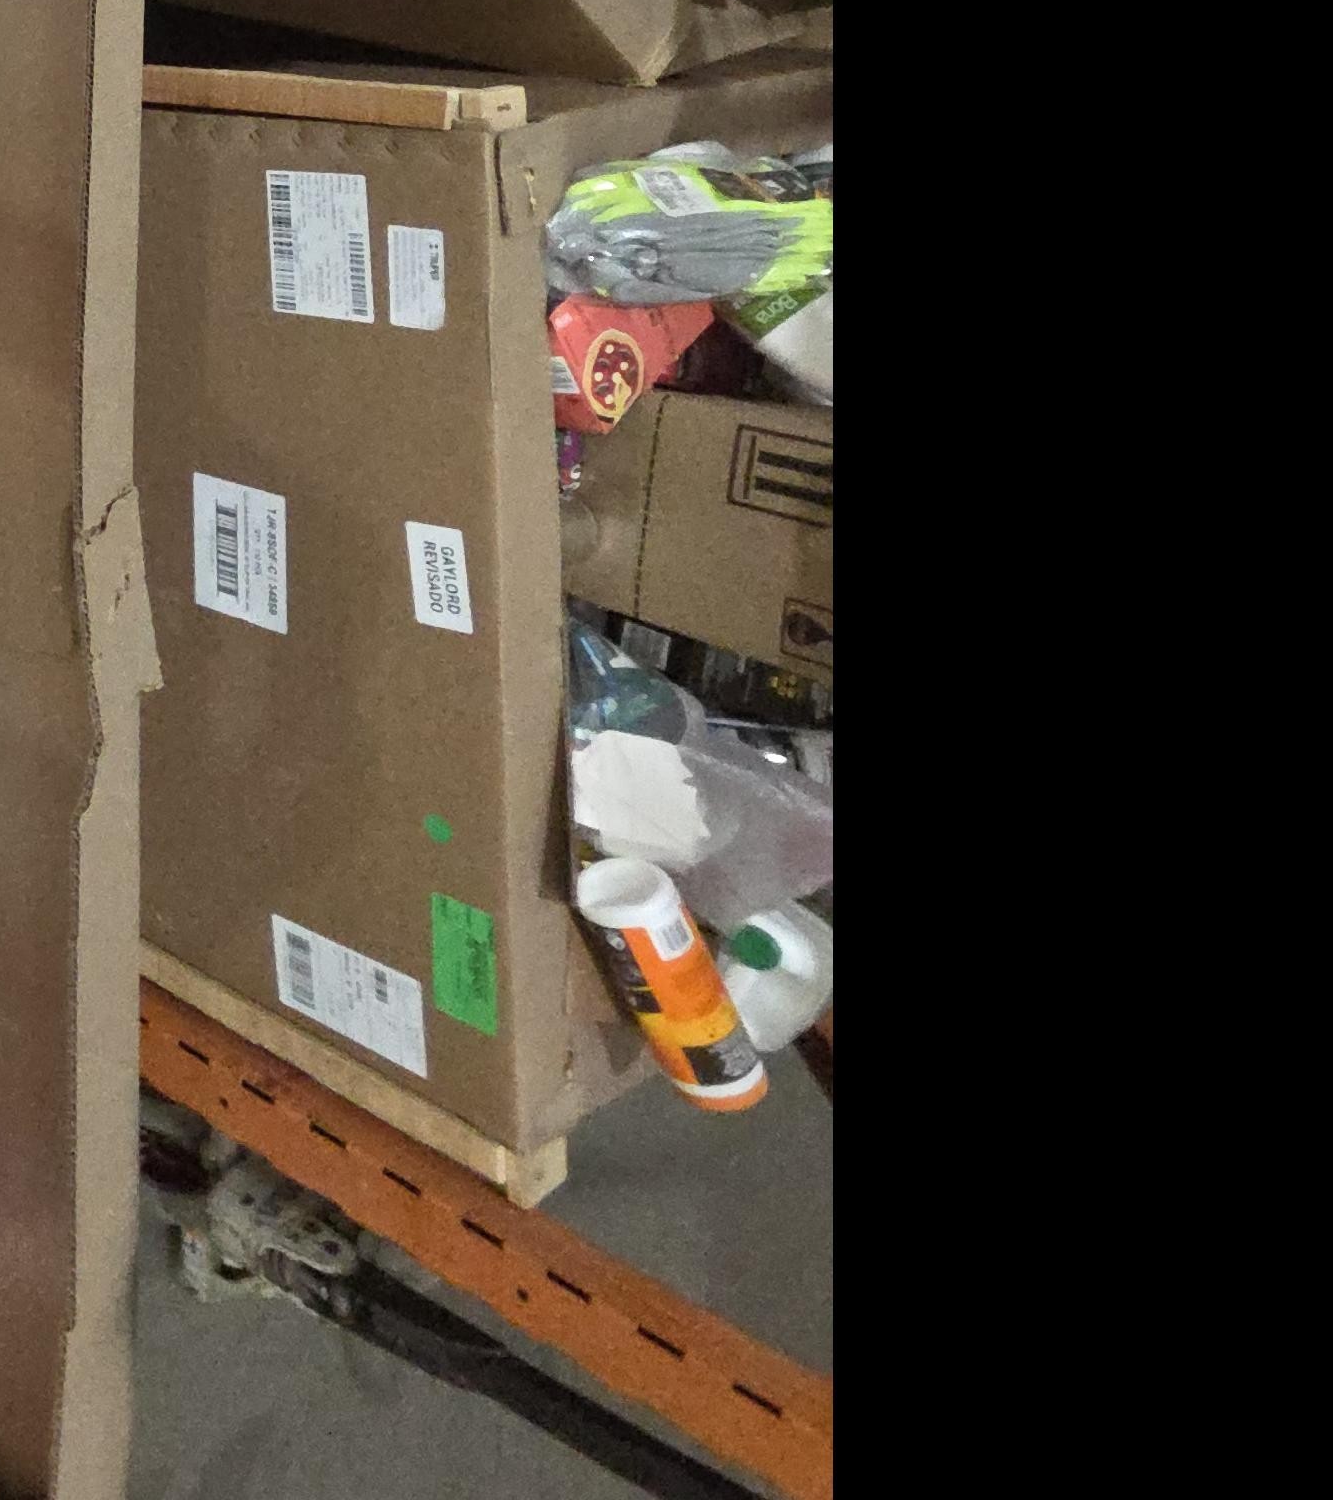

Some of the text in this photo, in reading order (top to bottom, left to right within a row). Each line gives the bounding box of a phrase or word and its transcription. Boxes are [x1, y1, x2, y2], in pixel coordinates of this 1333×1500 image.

[754, 291, 798, 326] Bona
[421, 539, 444, 614] REVISADO
[440, 544, 462, 615] GAYLORD
